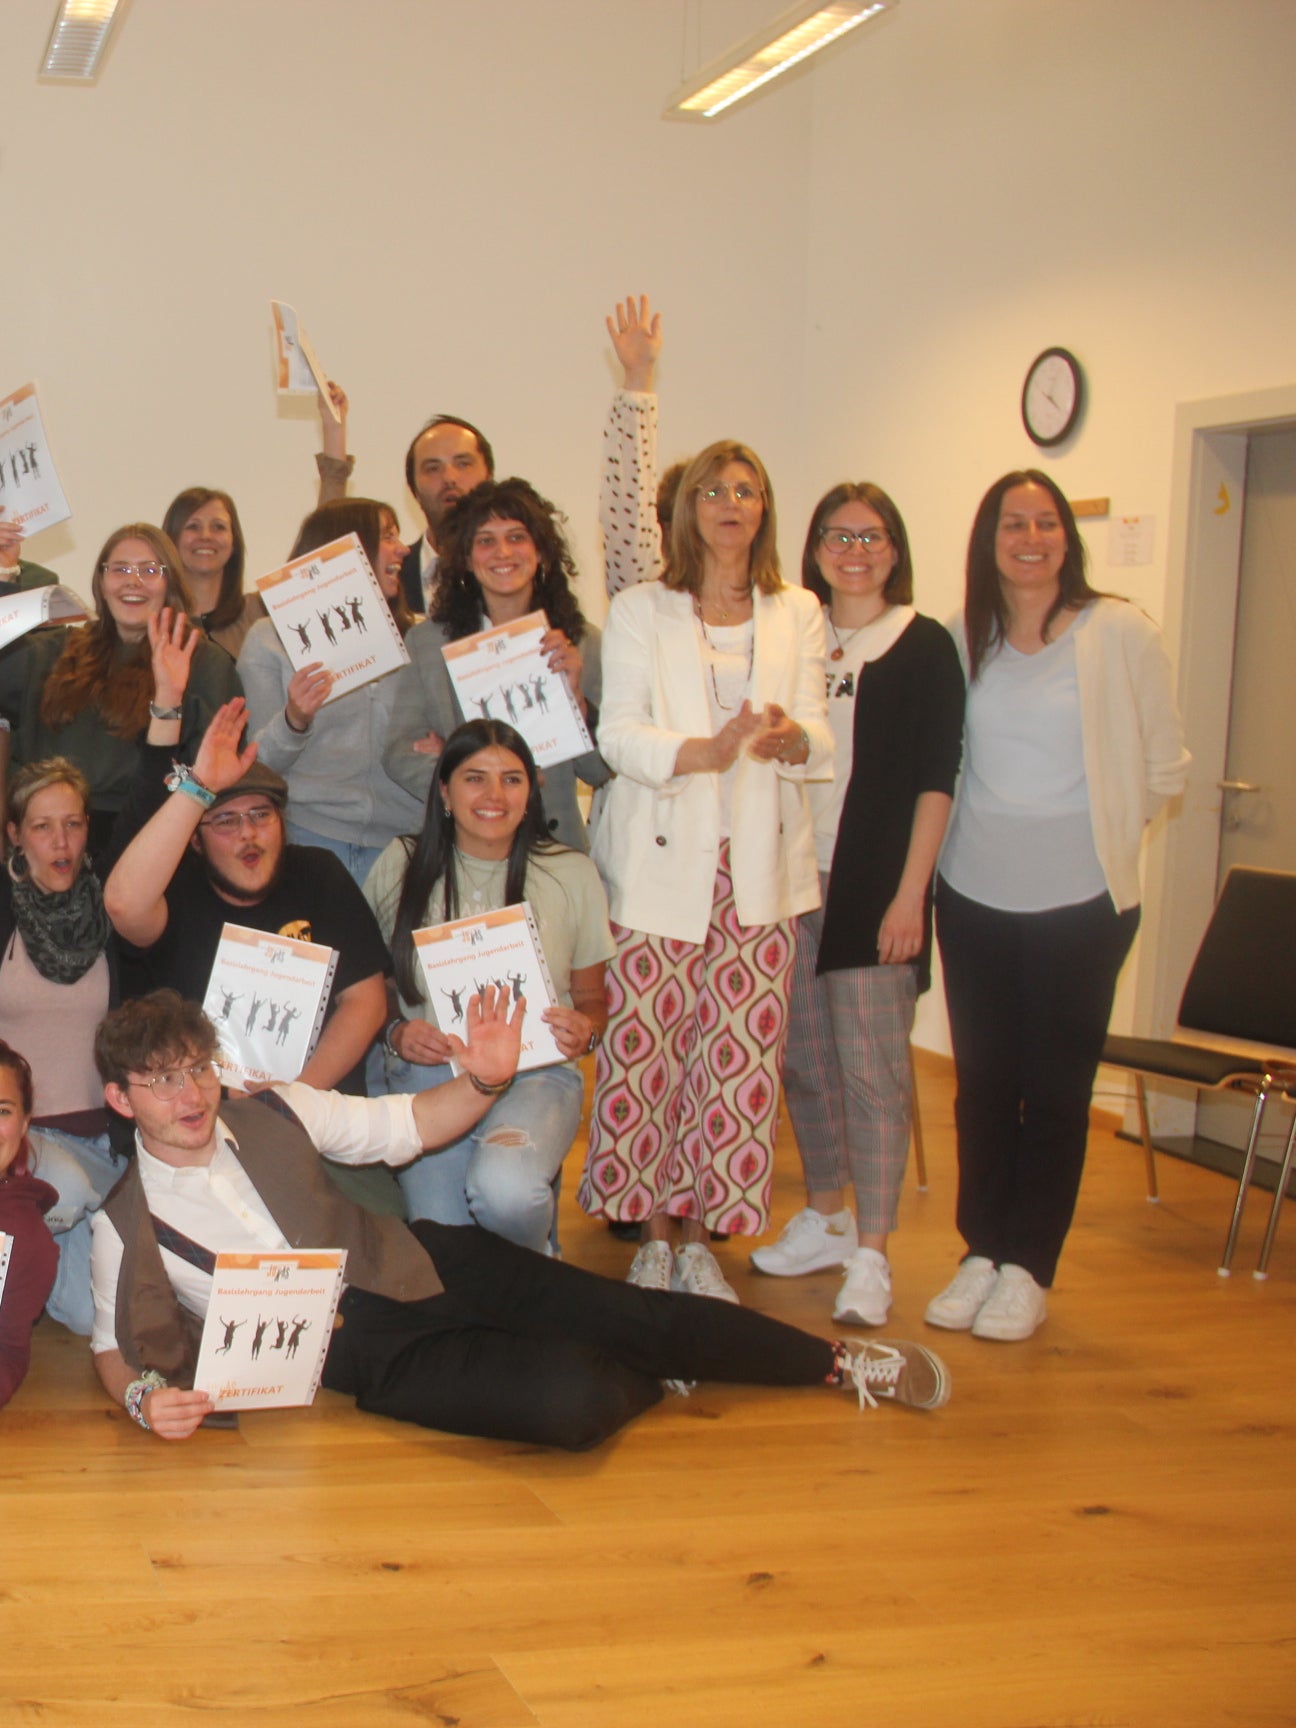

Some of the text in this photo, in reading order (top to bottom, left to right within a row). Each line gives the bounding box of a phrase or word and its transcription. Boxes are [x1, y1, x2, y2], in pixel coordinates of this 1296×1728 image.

[427, 940, 525, 971] Basislehrgang Jugendarbeit
[217, 1287, 326, 1297] Basislehrgang Jugendarbeit
[217, 1384, 285, 1400] ZERTIFIKAT
